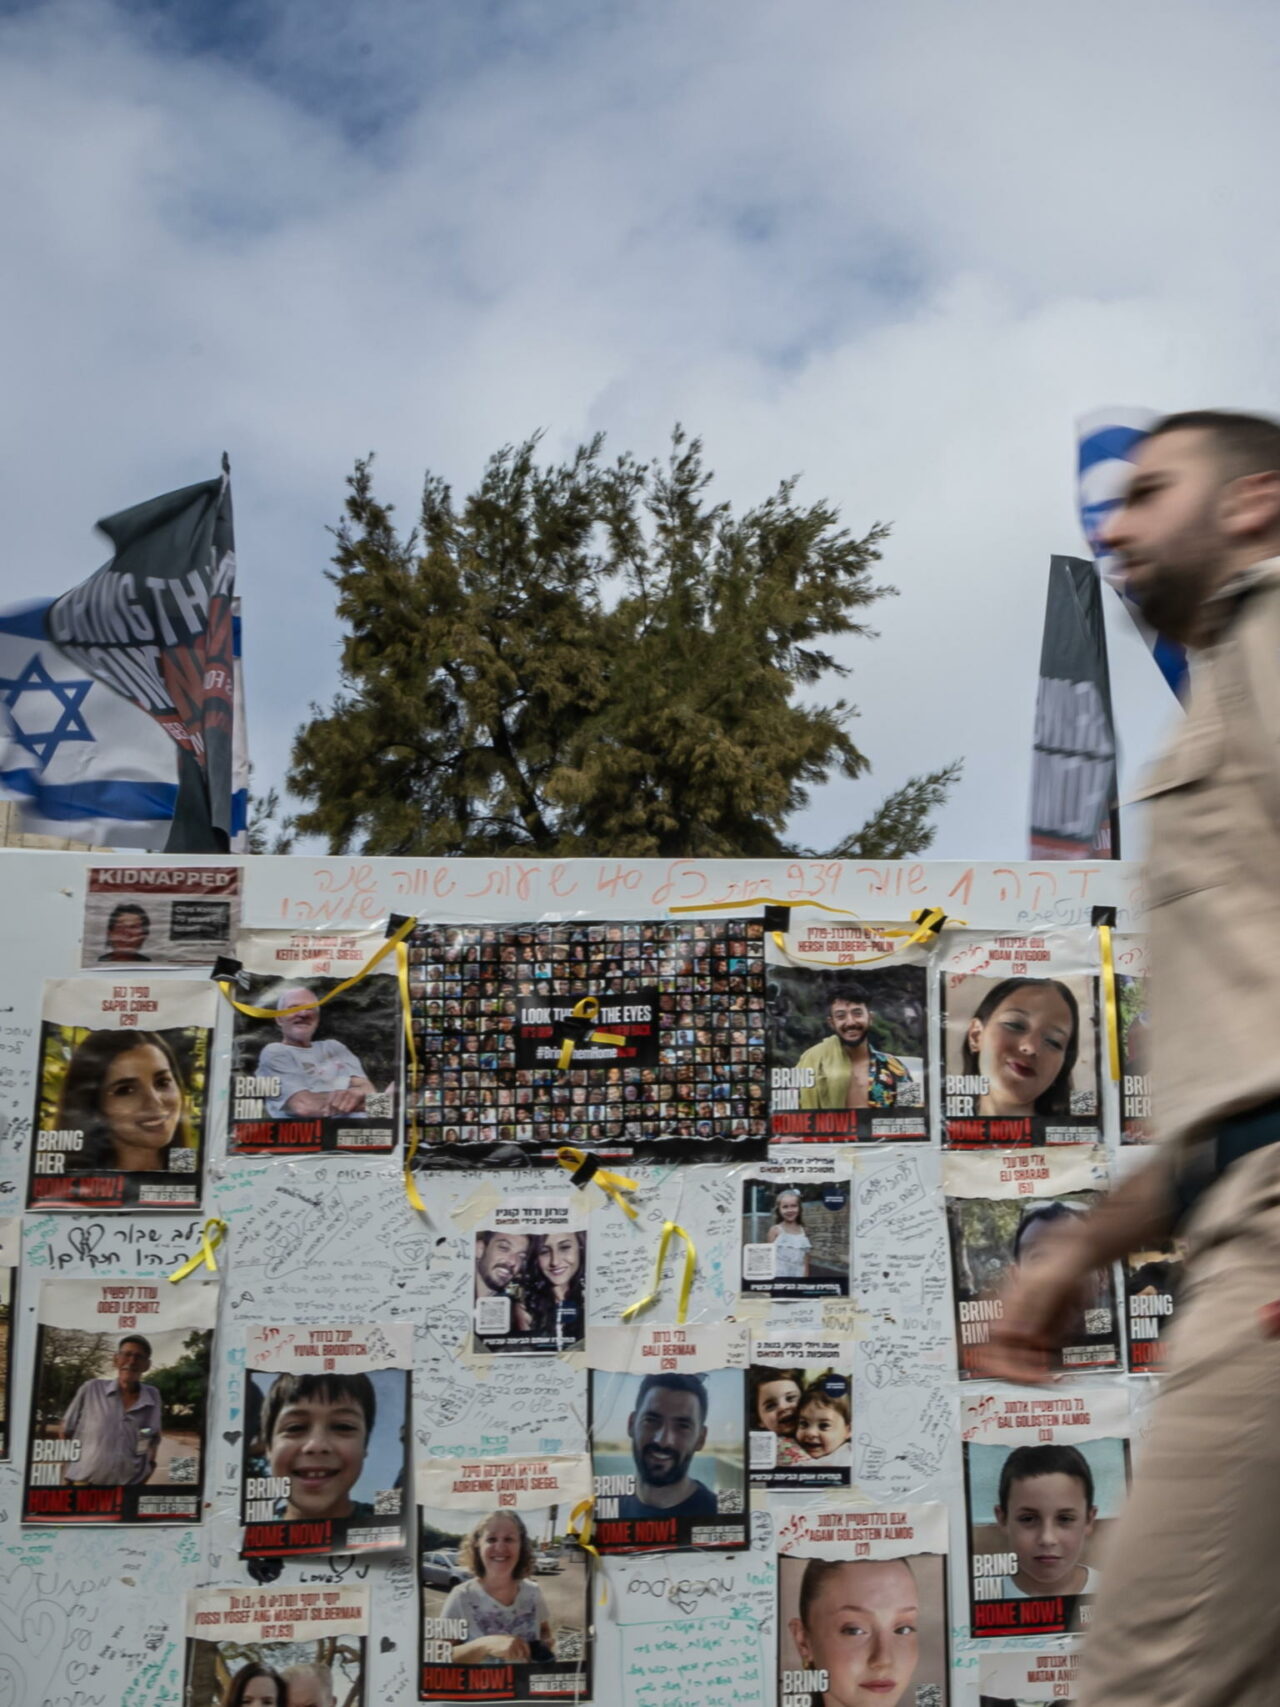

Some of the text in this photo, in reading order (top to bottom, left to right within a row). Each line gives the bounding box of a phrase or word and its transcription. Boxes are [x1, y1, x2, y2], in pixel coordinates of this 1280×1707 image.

[49, 573, 156, 644] RING
[99, 869, 231, 888] KIDNAPPED
[314, 865, 379, 894] שנה
[391, 863, 456, 897] שווה
[652, 860, 708, 905] כל
[993, 868, 1100, 911] דקה
[798, 941, 825, 953] HERSH
[988, 950, 1012, 962] NOAM
[102, 1000, 158, 1012] SAPIR COHEN
[522, 1005, 652, 1024] LOOK THE EYES
[234, 1077, 281, 1098] BRING
[770, 1068, 816, 1088] BRING
[946, 1076, 990, 1096] BRING
[234, 1098, 264, 1120] HIM
[772, 1089, 800, 1110] HIM
[946, 1096, 975, 1117] HER
[278, 1120, 322, 1142] NOW!
[772, 1114, 811, 1134] HOME
[814, 1112, 858, 1132] NOW!
[947, 1121, 987, 1142] HOME
[990, 1119, 1032, 1141] NOW!
[37, 1130, 82, 1152] BRING
[34, 1154, 65, 1174] HER
[1000, 1170, 1012, 1182] ELI
[959, 1301, 1004, 1322] BRING
[1130, 1295, 1174, 1316] BRING
[961, 1324, 990, 1344] HIM
[1130, 1318, 1159, 1339] HIM
[642, 1344, 697, 1357] GALI BERMAN
[1016, 1414, 1060, 1428] GOLDSTEIN
[1062, 1412, 1091, 1425] ALMOG
[33, 1440, 80, 1463] BRING
[30, 1463, 62, 1486] HIM
[452, 1479, 494, 1493] ADRIENNE
[530, 1476, 560, 1490] SIEGEL
[76, 1486, 124, 1512] NOW!
[246, 1477, 292, 1500] BRING
[246, 1500, 274, 1523] HIM
[288, 1521, 332, 1546] NOW!
[634, 1518, 676, 1542] NOW!
[809, 1526, 914, 1542] AGAM GOLDSTEIN ALMOG
[973, 1552, 1018, 1578] BRING
[974, 1578, 1004, 1600] HIM
[195, 1612, 222, 1626] YOSSI
[274, 1608, 308, 1622] MARGIT
[310, 1606, 362, 1621] SILBERMAN
[974, 1597, 1064, 1627] HOME NOW!
[424, 1618, 468, 1641] BRING
[423, 1640, 454, 1664] HER
[423, 1668, 466, 1690] HOME
[468, 1666, 515, 1690] NOW!
[783, 1670, 829, 1693] BRING
[1027, 1670, 1056, 1682] MATAN
